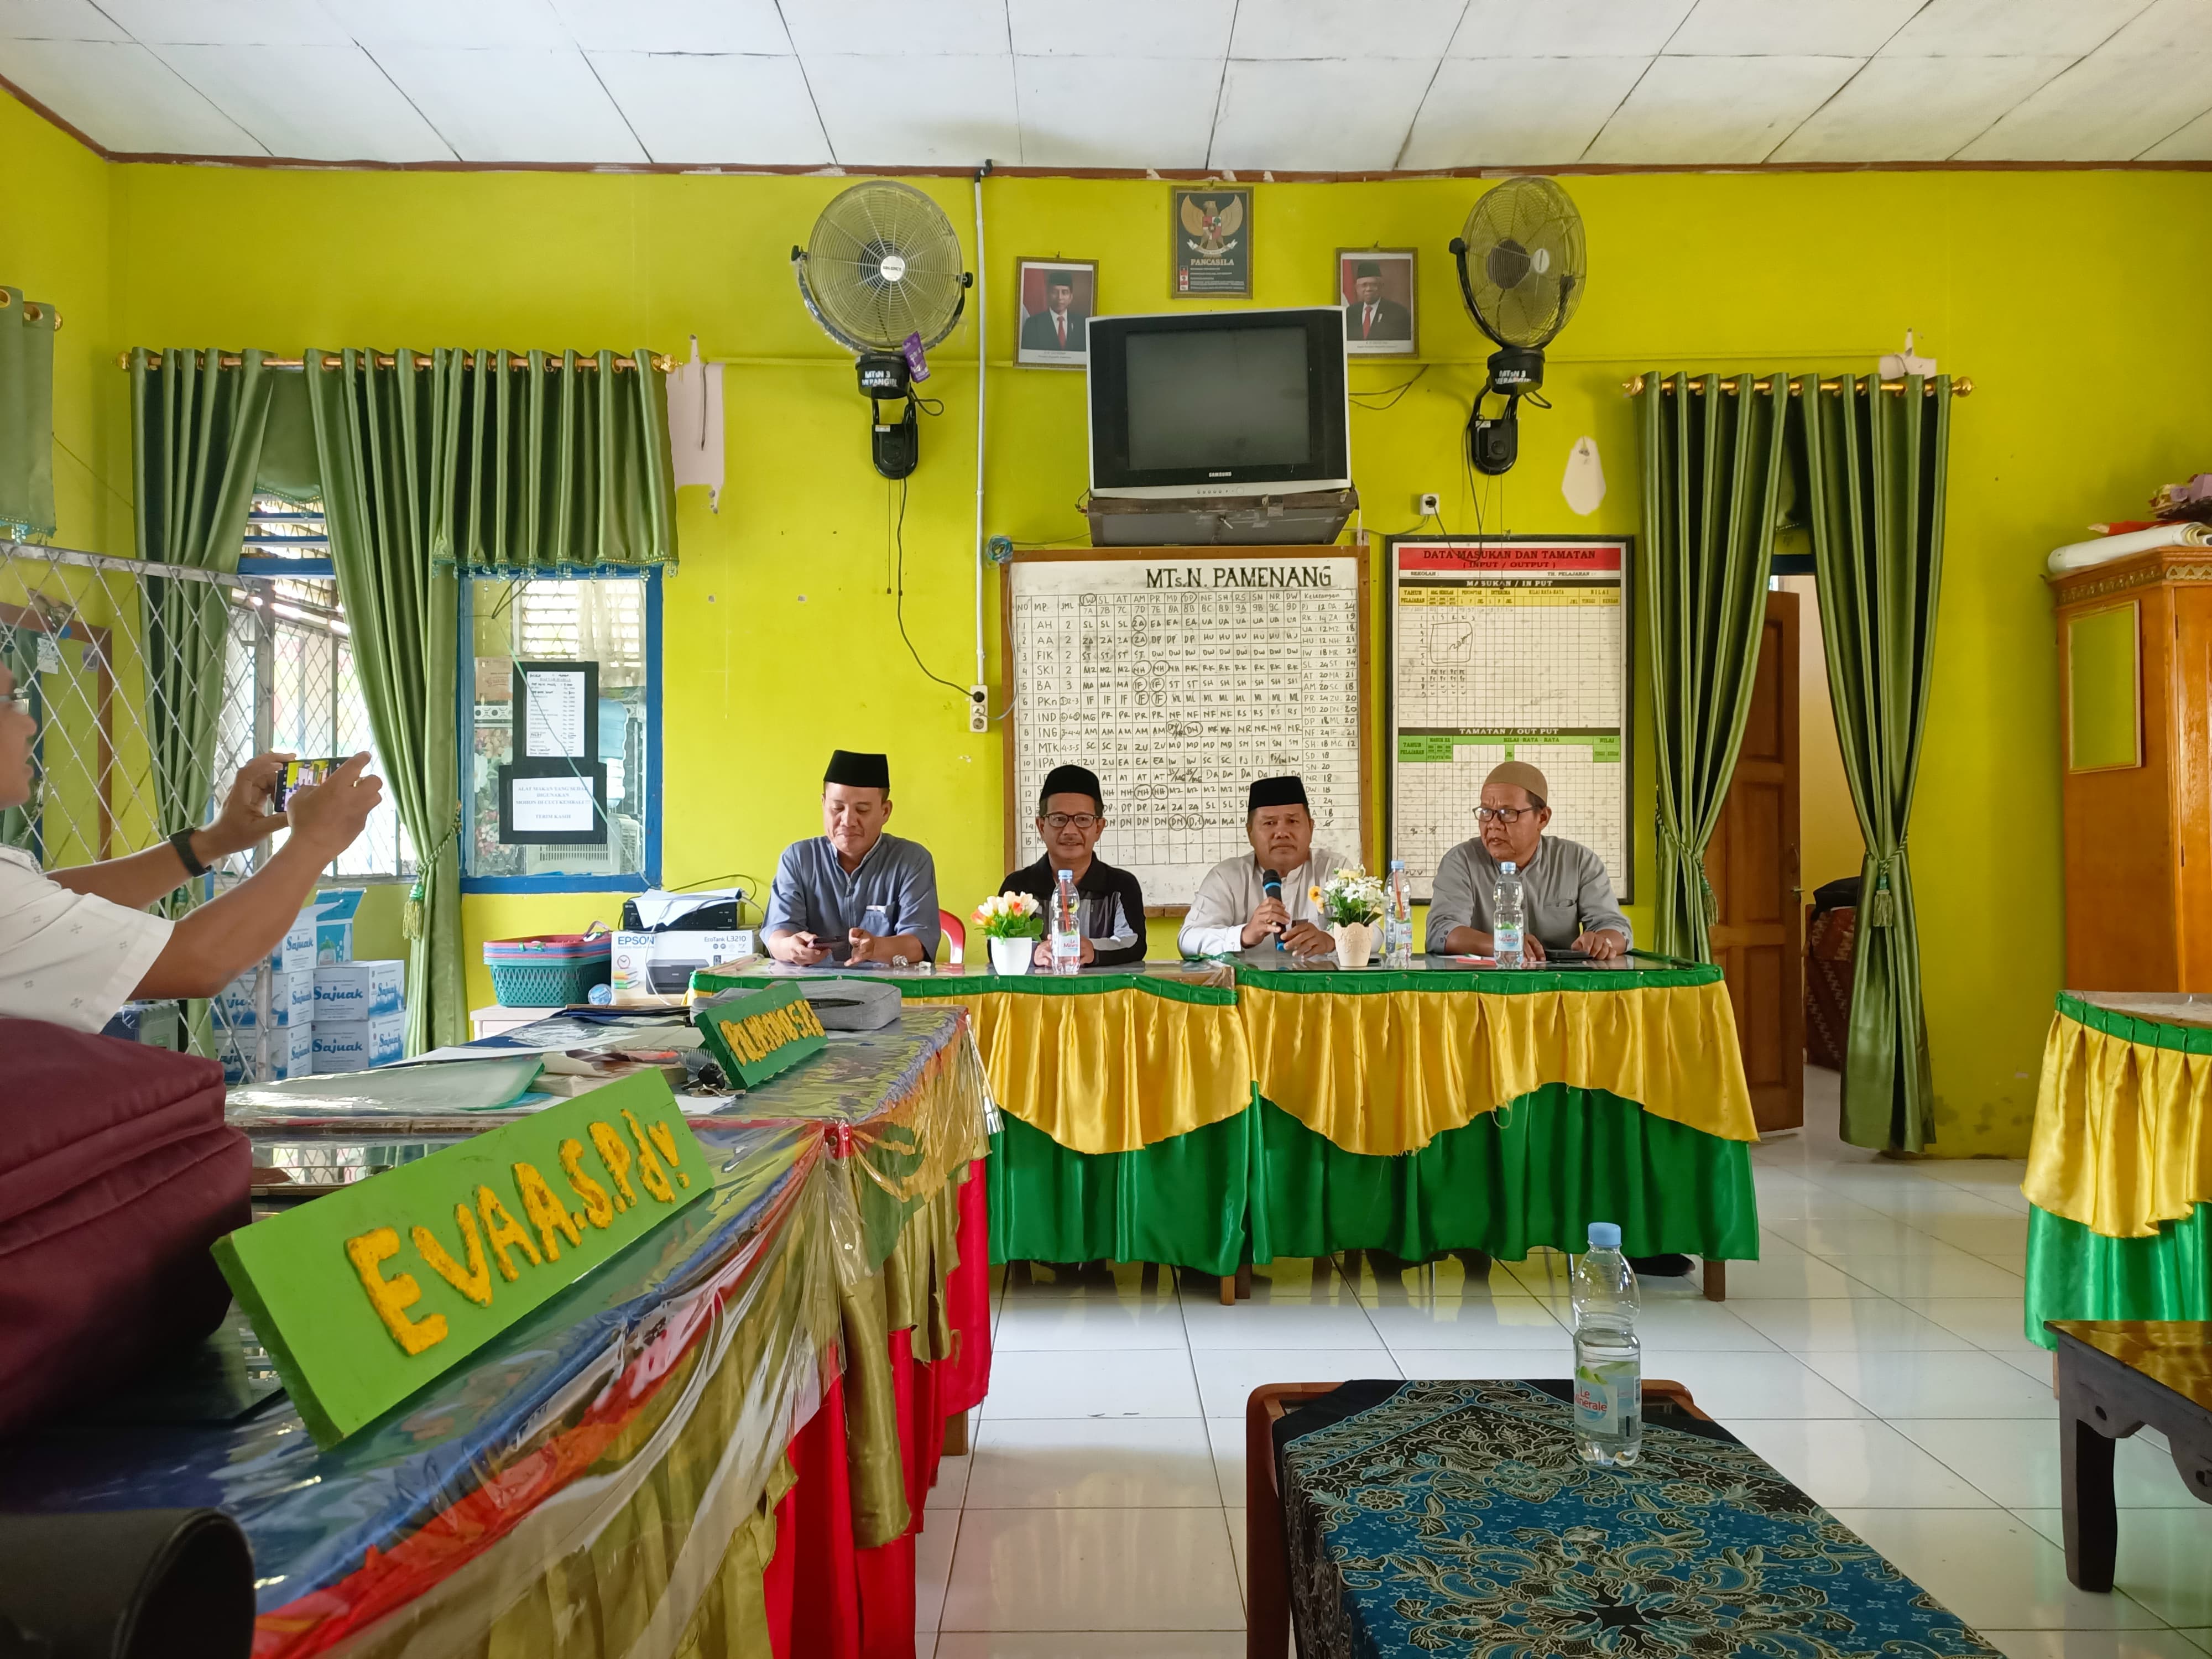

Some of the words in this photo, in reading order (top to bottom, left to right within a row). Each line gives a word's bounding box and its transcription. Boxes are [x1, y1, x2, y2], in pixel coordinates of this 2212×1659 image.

[1423, 550, 1453, 559] DATA
[1457, 550, 1511, 559] MASUKAN
[1515, 550, 1537, 559] DAN
[1542, 550, 1595, 559] TAMATAN
[1213, 566, 1331, 588] PAMENANG
[1099, 596, 1109, 604] SL
[1150, 594, 1161, 603] PR
[1167, 594, 1177, 603] MD
[1037, 620, 1052, 629] AH
[1066, 620, 1071, 629] 2
[1100, 620, 1110, 628] SL
[1022, 637, 1026, 645] 2
[1037, 636, 1053, 644] AA
[1066, 635, 1071, 644] 2
[1022, 653, 1027, 661] 3
[1037, 650, 1053, 660] FIK
[1066, 651, 1072, 659] 2
[1037, 665, 1053, 675] SKI
[1066, 666, 1072, 674] 2
[1303, 671, 1313, 680] AT
[1037, 681, 1052, 691] BA
[1066, 681, 1072, 690] 3
[1037, 696, 1057, 706] PKn
[1037, 713, 1057, 722] IND
[1039, 728, 1057, 738] ING
[1039, 743, 1060, 753] MTK
[1039, 758, 1056, 768] IPA
[1323, 774, 1332, 782] 18
[1025, 806, 1032, 815] 13
[1025, 837, 1032, 846] 15
[286, 935, 314, 952] Sajuak
[618, 936, 654, 945] EPSON
[314, 985, 363, 1001] Sajuak
[312, 1038, 363, 1053] Sajuak
[1580, 1386, 1590, 1399] Le
